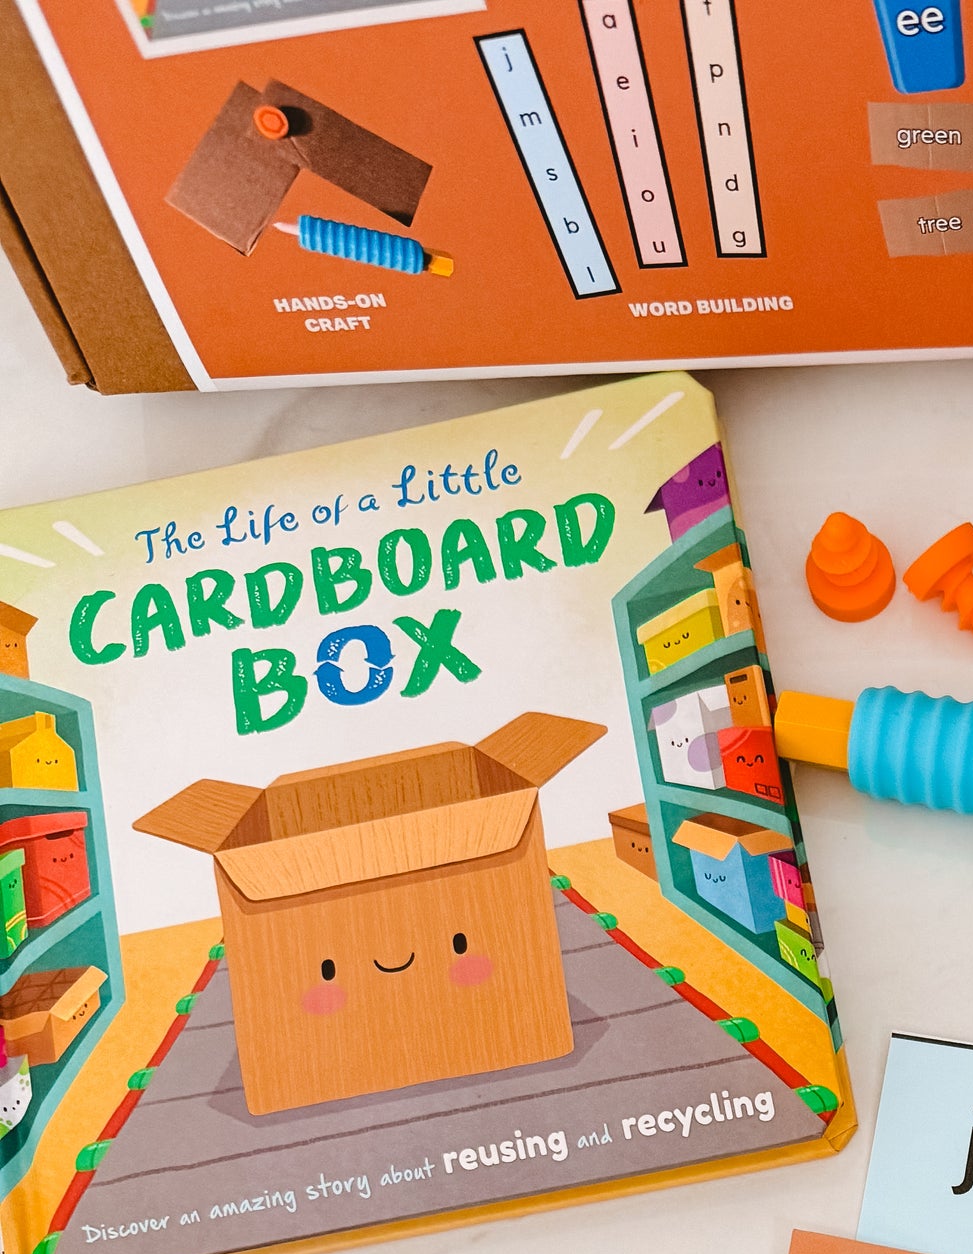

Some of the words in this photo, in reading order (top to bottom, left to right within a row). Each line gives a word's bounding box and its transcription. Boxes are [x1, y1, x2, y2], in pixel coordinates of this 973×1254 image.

[601, 13, 617, 29] a
[896, 6, 945, 37] ee
[501, 46, 514, 73] j
[709, 62, 724, 83] p
[615, 75, 631, 91] e
[519, 110, 542, 127] m
[630, 128, 639, 148] i
[717, 121, 732, 137] n
[896, 126, 962, 149] green
[546, 167, 559, 182] s
[725, 174, 740, 192] d
[640, 189, 655, 203] o
[562, 216, 580, 235] b
[917, 214, 963, 235] tree
[652, 240, 667, 254] u
[732, 229, 747, 248] g
[273, 293, 387, 313] HANDS-ON
[628, 300, 693, 318] WORD
[696, 295, 794, 315] BUILDING
[304, 316, 371, 333] CRAFT
[134, 520, 206, 564] The
[215, 505, 299, 546] Life
[311, 494, 348, 525] of
[358, 493, 381, 513] a
[391, 448, 522, 508] Little
[69, 492, 617, 665] CARDBOARD
[230, 608, 483, 735] BOX
[82, 1214, 170, 1244] Discover
[179, 1209, 201, 1226] an
[209, 1188, 297, 1220] amazing
[305, 1173, 372, 1200] story
[380, 1162, 435, 1187] about
[443, 1130, 569, 1175] reusing
[576, 1123, 614, 1150] and
[621, 1090, 776, 1140] recycling
